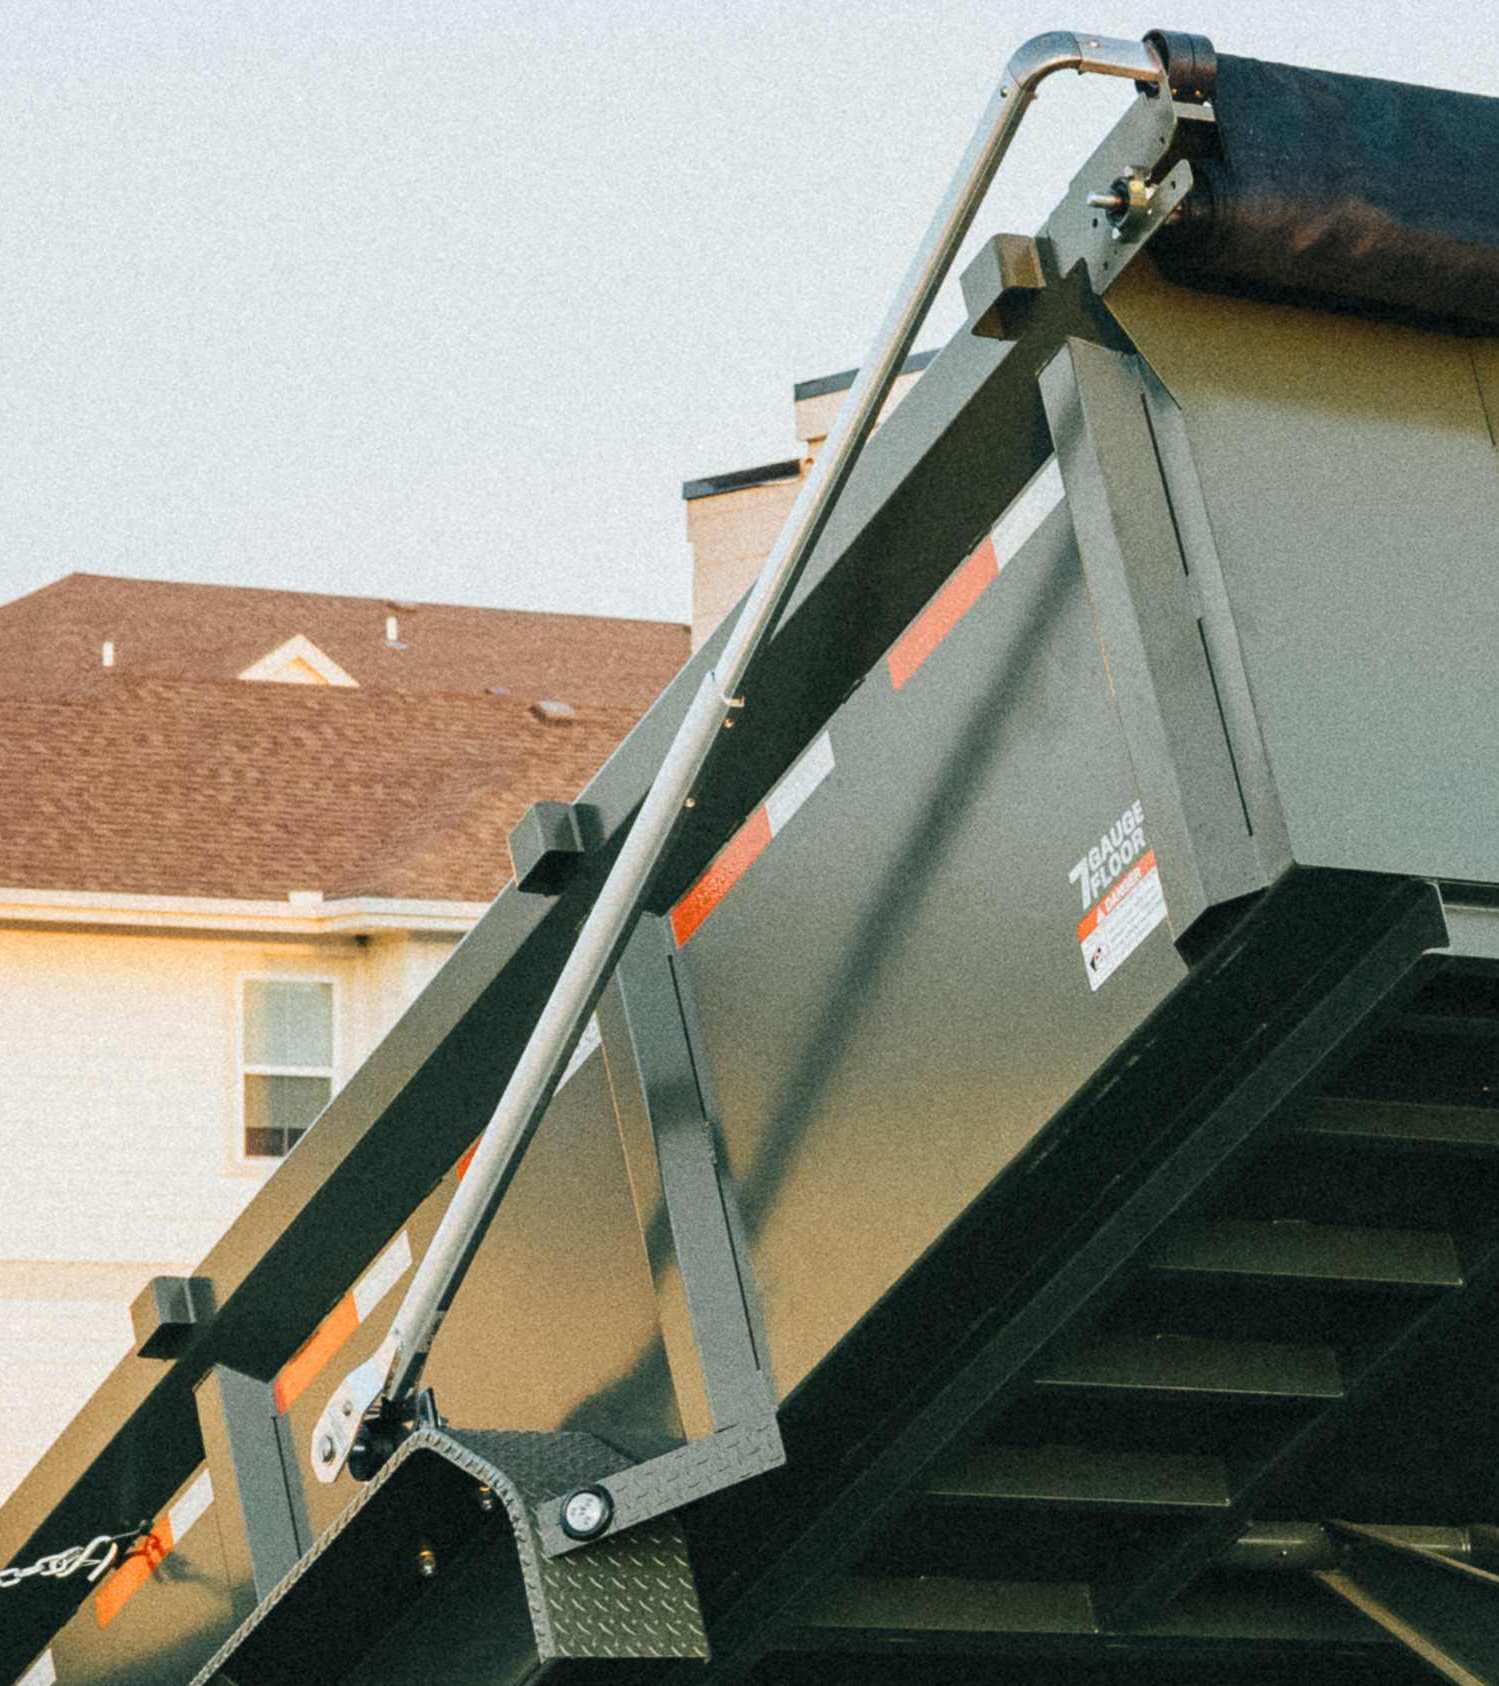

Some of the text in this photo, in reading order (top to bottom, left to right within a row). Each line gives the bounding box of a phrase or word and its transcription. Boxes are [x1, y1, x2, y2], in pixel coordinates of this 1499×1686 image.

[1068, 856, 1091, 912] 7
[1089, 799, 1145, 869] GAUGE
[1090, 828, 1146, 898] FLOOR
